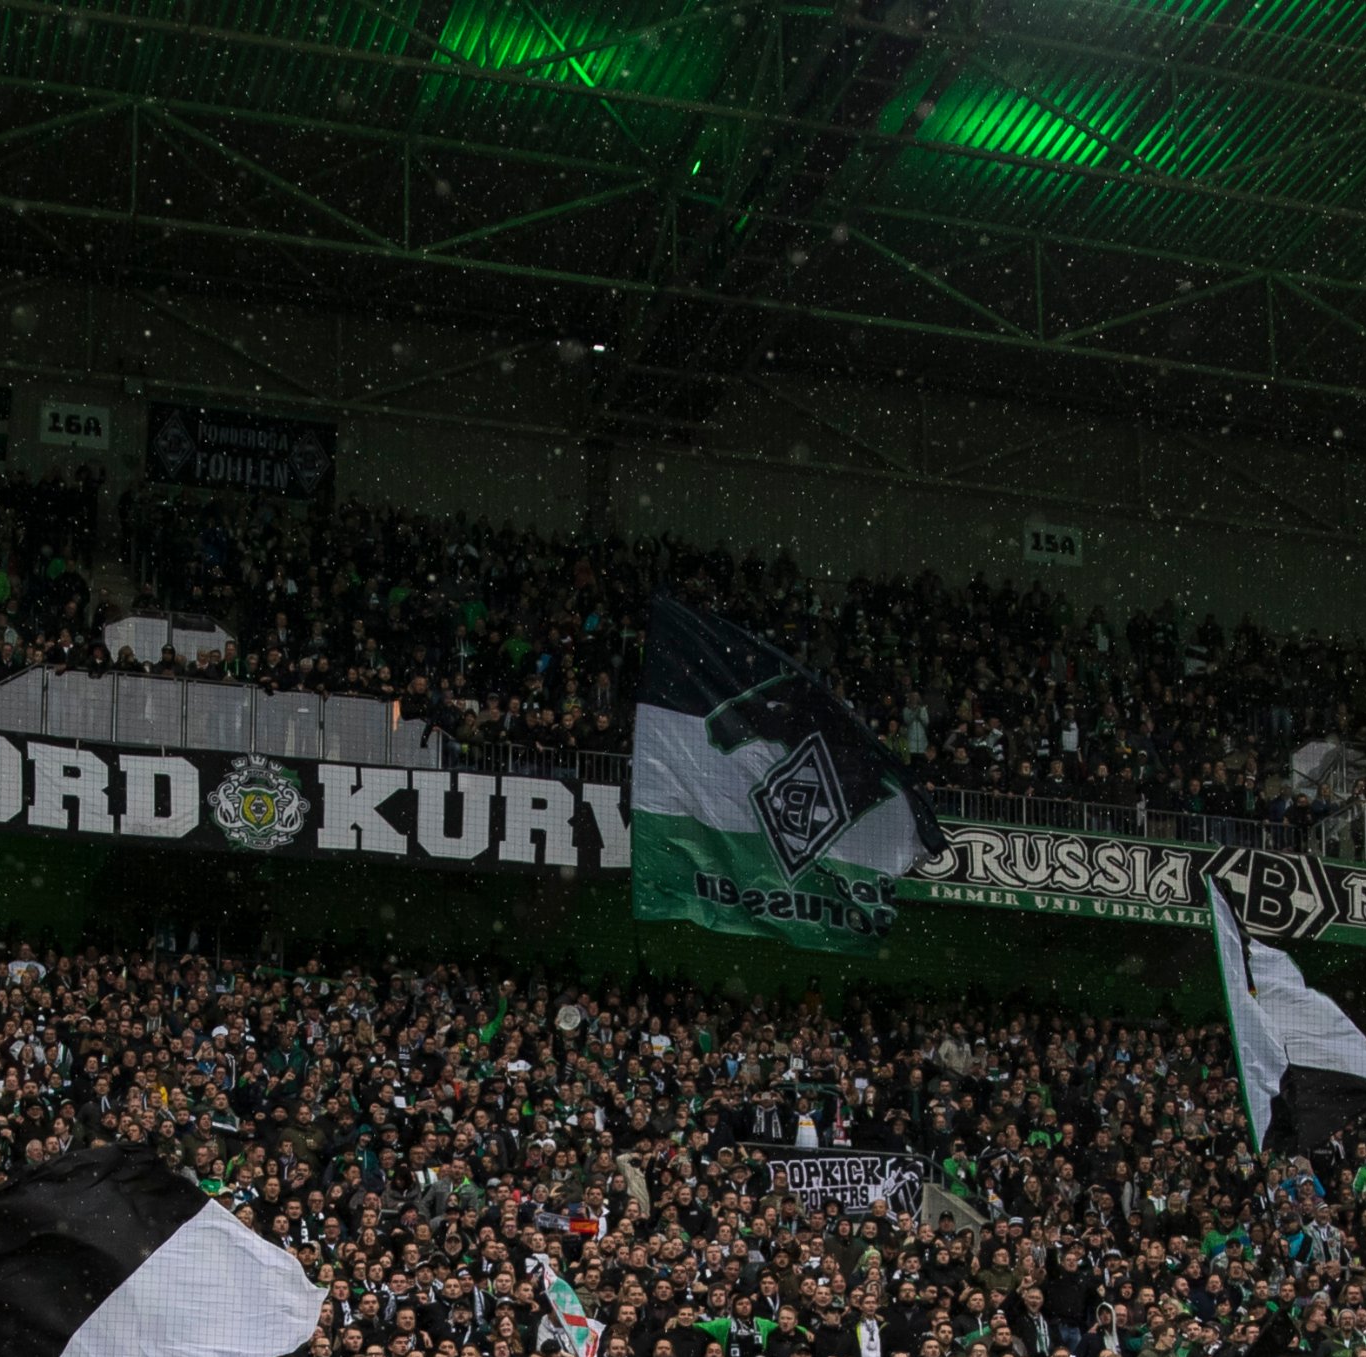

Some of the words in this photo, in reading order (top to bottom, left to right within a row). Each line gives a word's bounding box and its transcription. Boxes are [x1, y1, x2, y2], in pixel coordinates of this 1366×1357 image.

[48, 410, 102, 437] 16A
[1032, 532, 1075, 555] 15A
[930, 884, 1020, 907] IMMER
[1035, 895, 1082, 915] UND
